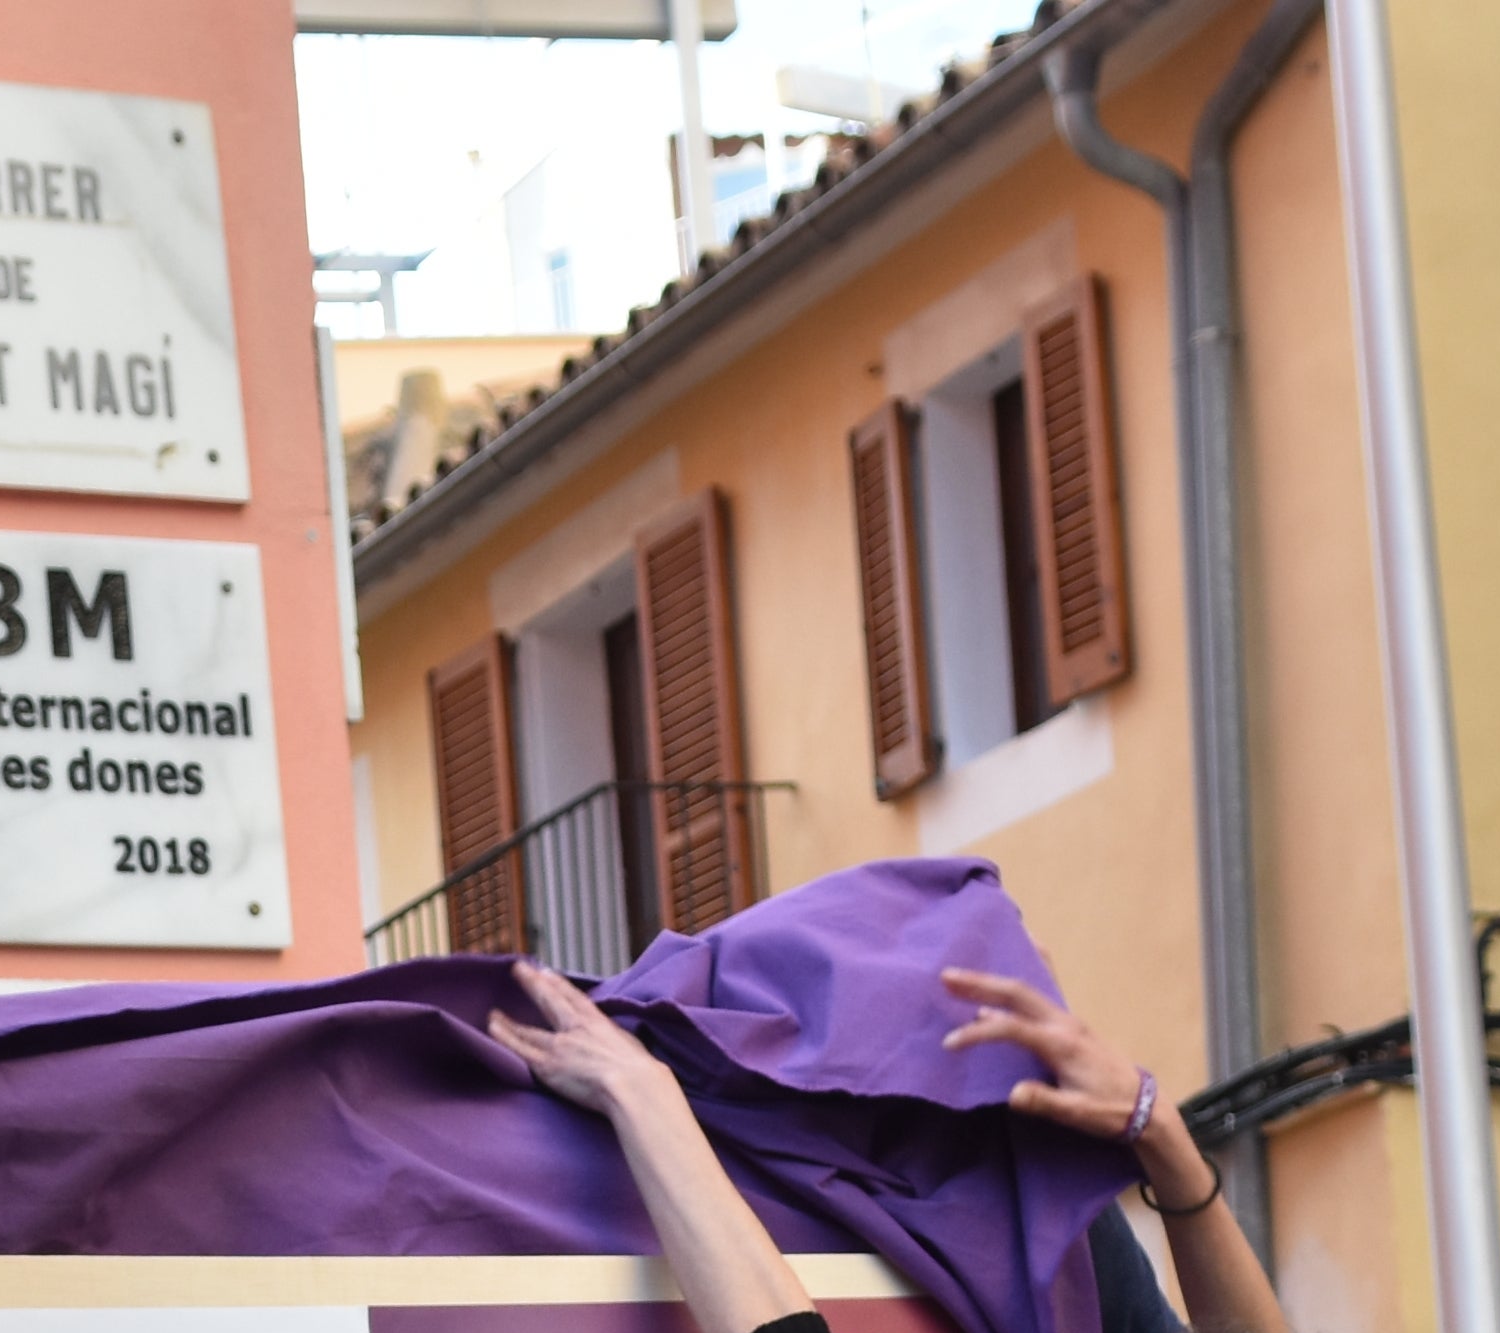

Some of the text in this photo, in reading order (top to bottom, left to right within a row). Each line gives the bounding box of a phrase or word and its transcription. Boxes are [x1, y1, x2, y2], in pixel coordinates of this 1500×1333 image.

[45, 333, 178, 420] MAGÍ
[67, 746, 205, 797] dones
[112, 836, 211, 877] 2018
